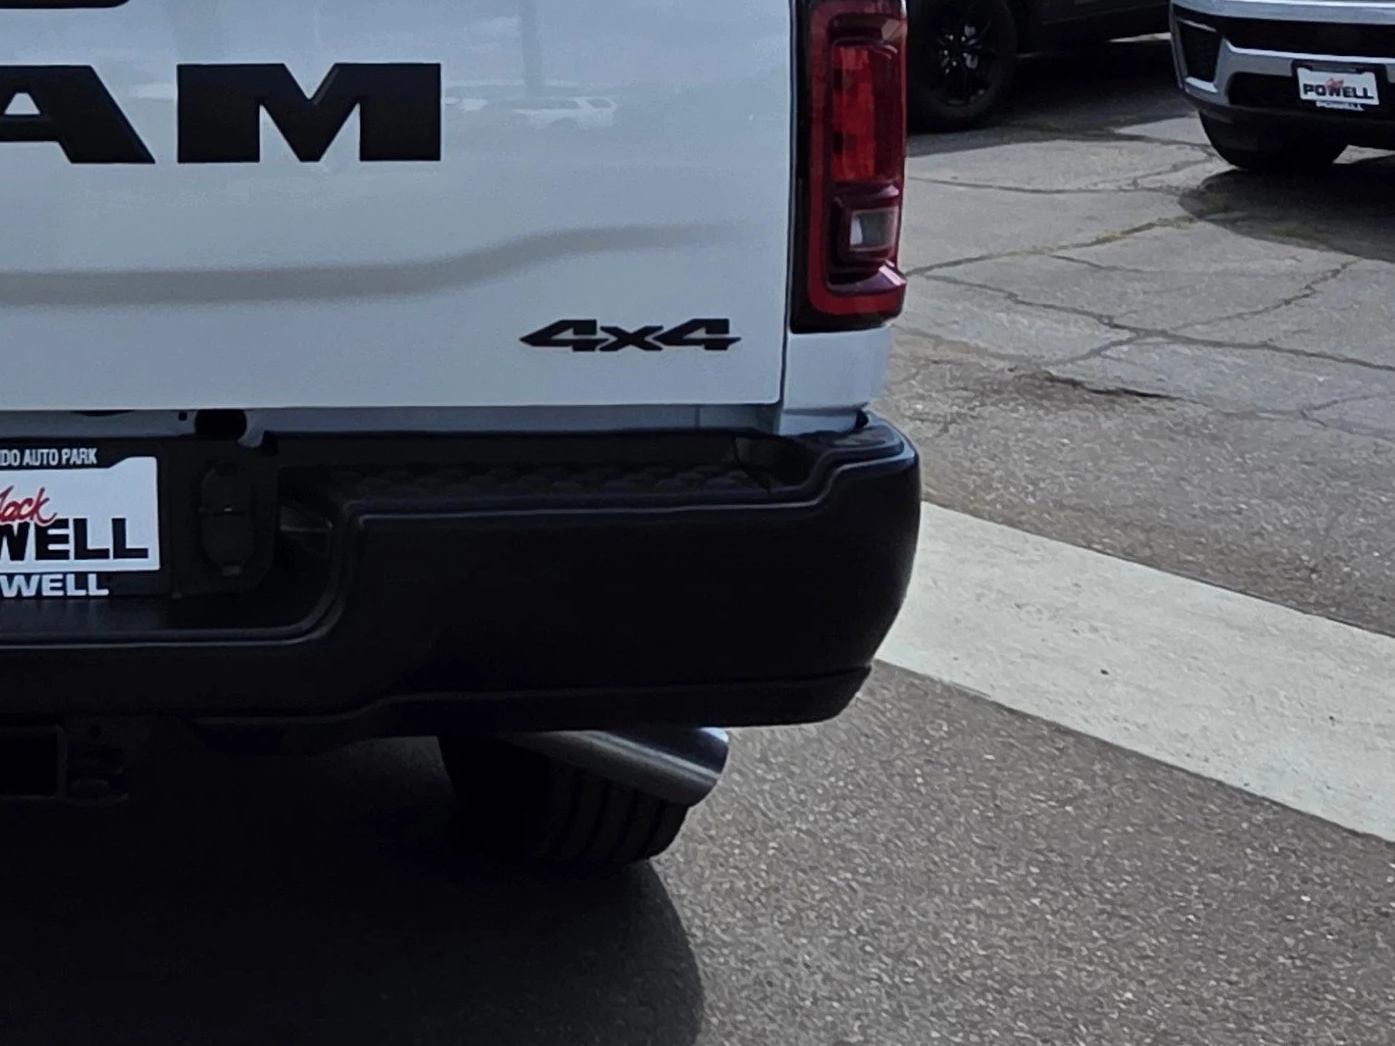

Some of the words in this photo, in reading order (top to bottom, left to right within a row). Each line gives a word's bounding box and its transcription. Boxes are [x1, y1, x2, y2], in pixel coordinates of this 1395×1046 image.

[1303, 83, 1375, 100] POWELL
[519, 318, 742, 352] 4x4
[23, 449, 59, 466] AUTO
[61, 448, 98, 465] PARK
